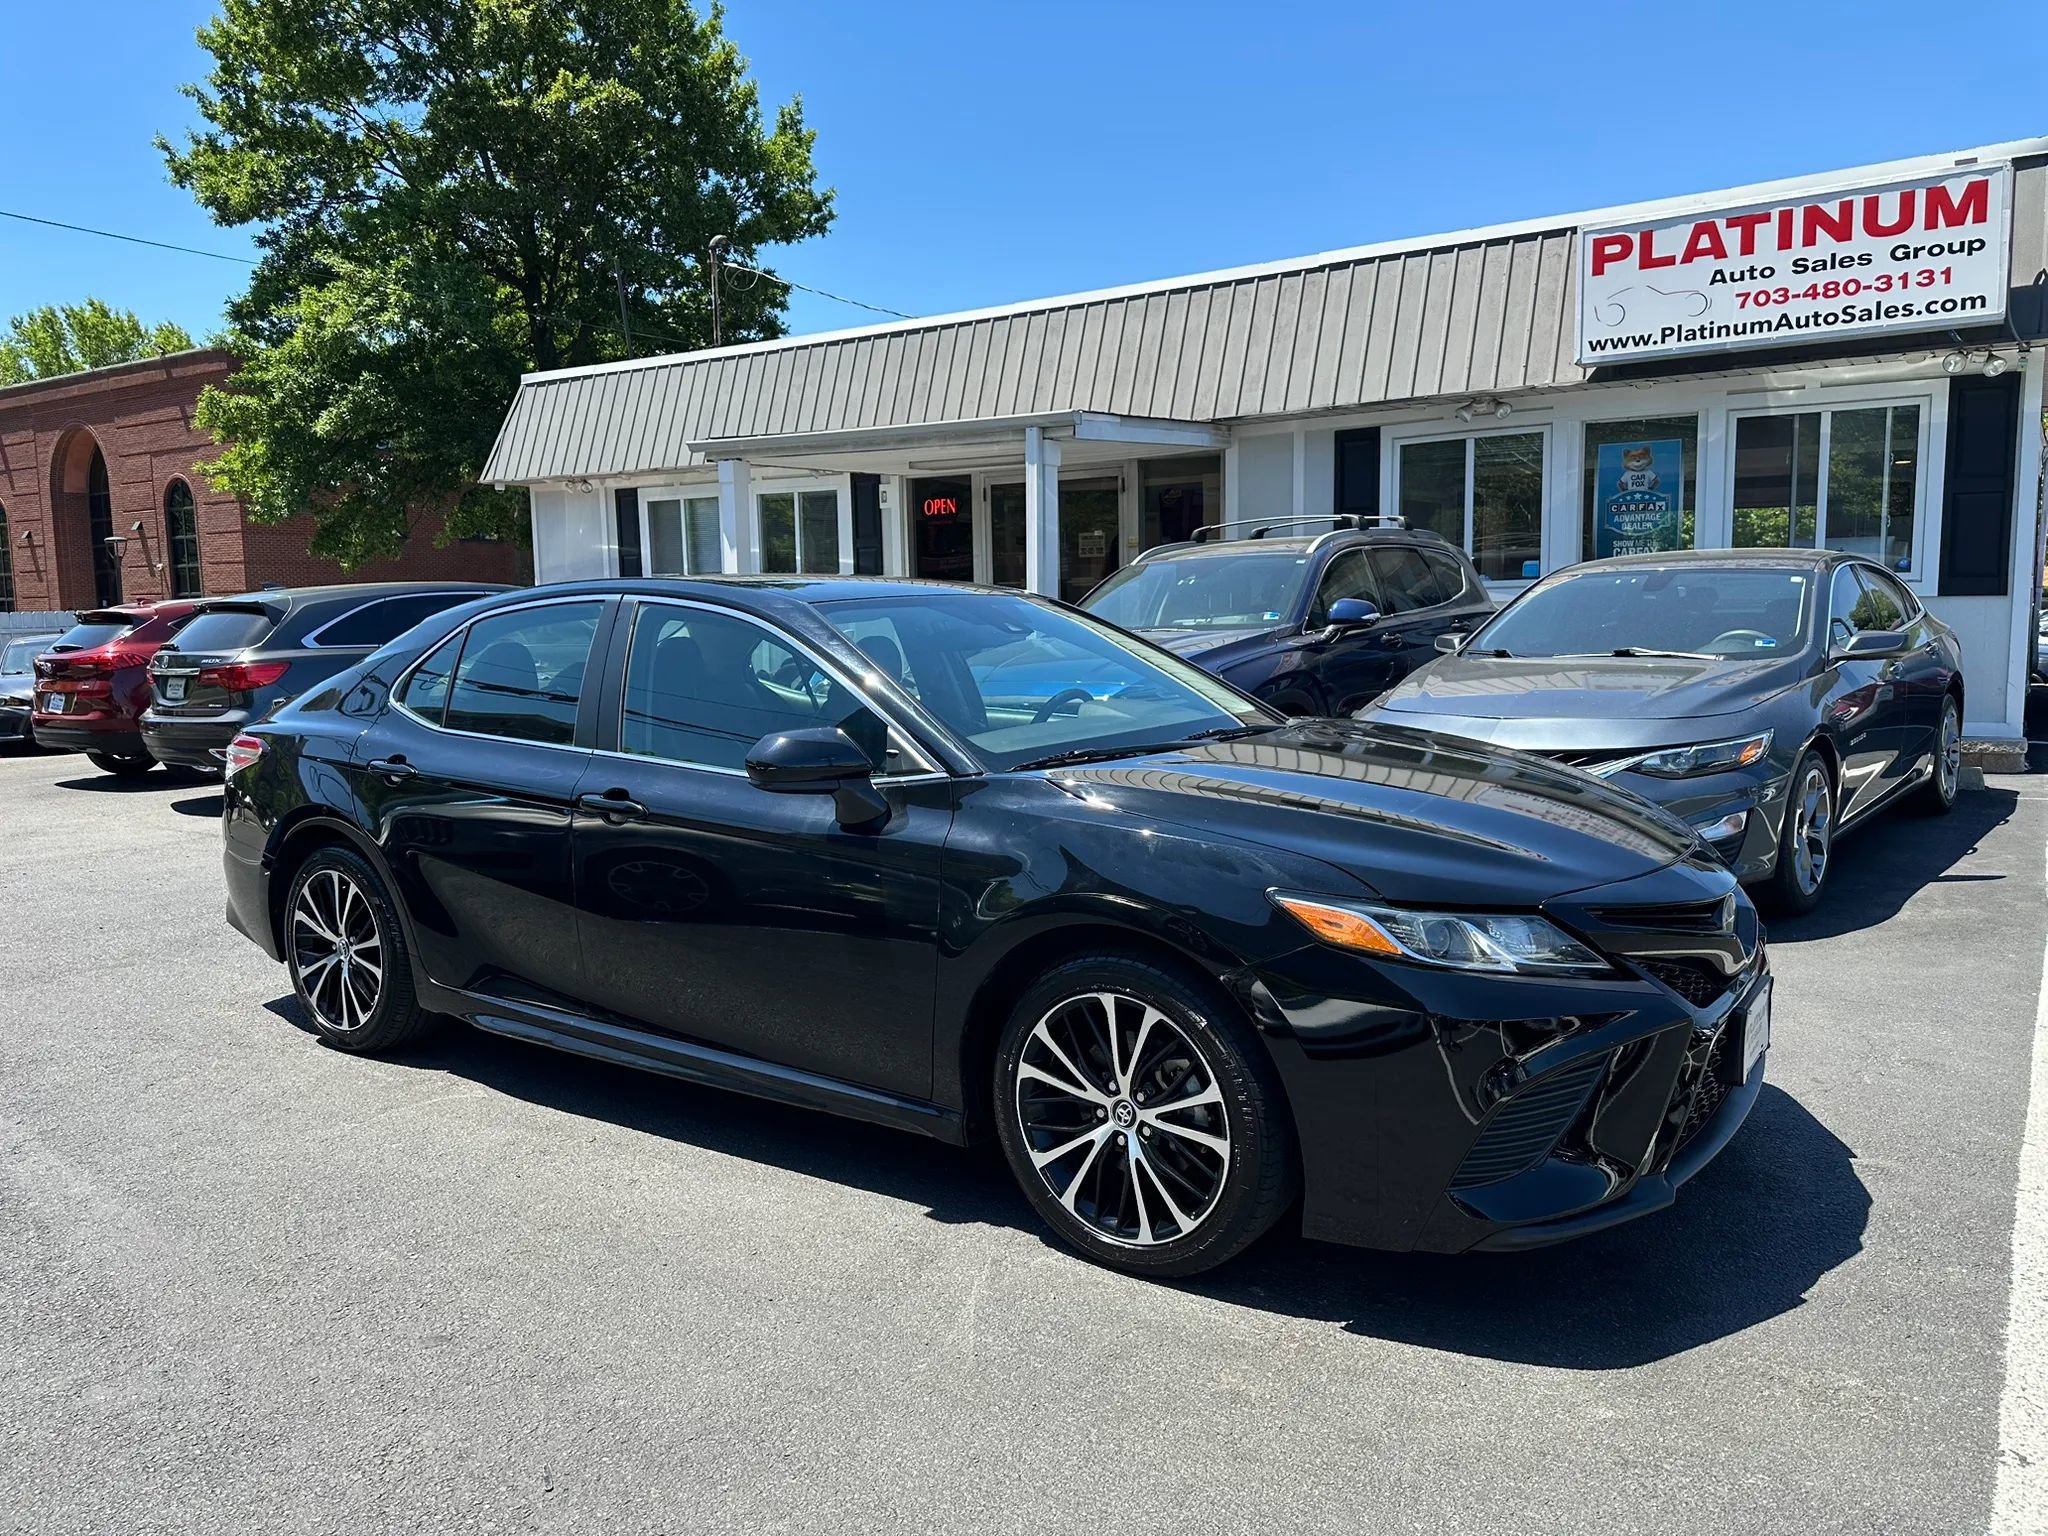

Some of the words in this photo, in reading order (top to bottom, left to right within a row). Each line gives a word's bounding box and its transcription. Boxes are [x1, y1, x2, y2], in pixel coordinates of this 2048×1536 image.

[1591, 178, 1989, 277] PLATINUM
[1708, 263, 1776, 286] Auto
[1791, 249, 1873, 275] Sales
[1889, 237, 1986, 263] Group
[1735, 267, 1953, 310] 703-480-3131
[1588, 291, 1987, 352] www.PlatinumAutoSales.com
[924, 498, 956, 515] OPEN
[1611, 502, 1666, 512] CARFAX
[1614, 513, 1661, 522] ADVANTAGE
[1622, 522, 1653, 530] DEALER
